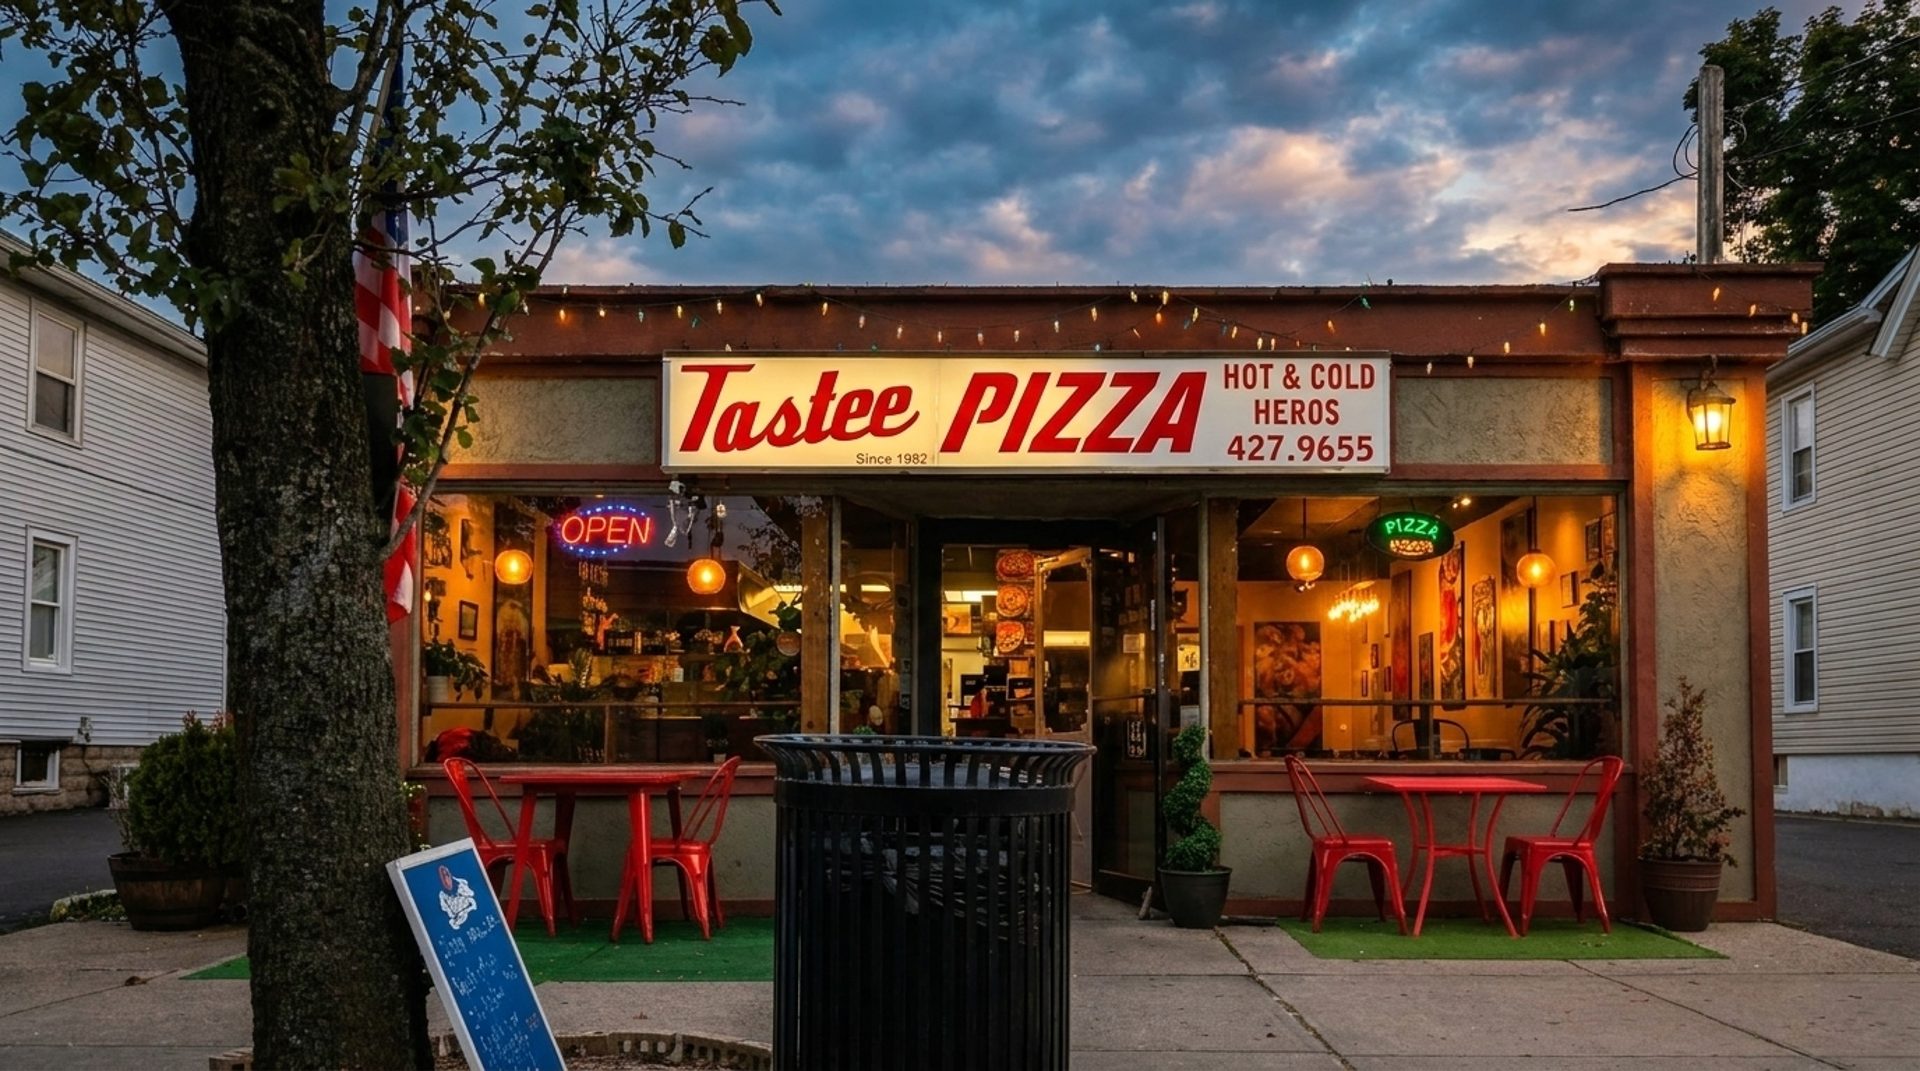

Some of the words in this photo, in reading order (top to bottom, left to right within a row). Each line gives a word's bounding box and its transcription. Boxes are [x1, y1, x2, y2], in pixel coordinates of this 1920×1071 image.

[1223, 363, 1274, 390] HOT
[1282, 363, 1301, 390] &
[1310, 363, 1376, 390] COLD
[679, 364, 920, 453] Tastee
[939, 371, 1208, 453] PIZZA
[1254, 399, 1340, 425] HEROS
[856, 453, 892, 465] Since
[897, 453, 928, 465] 1982
[1227, 434, 1374, 462] 427.9655
[561, 516, 651, 545] OPEN
[1385, 518, 1439, 540] PIZZA
